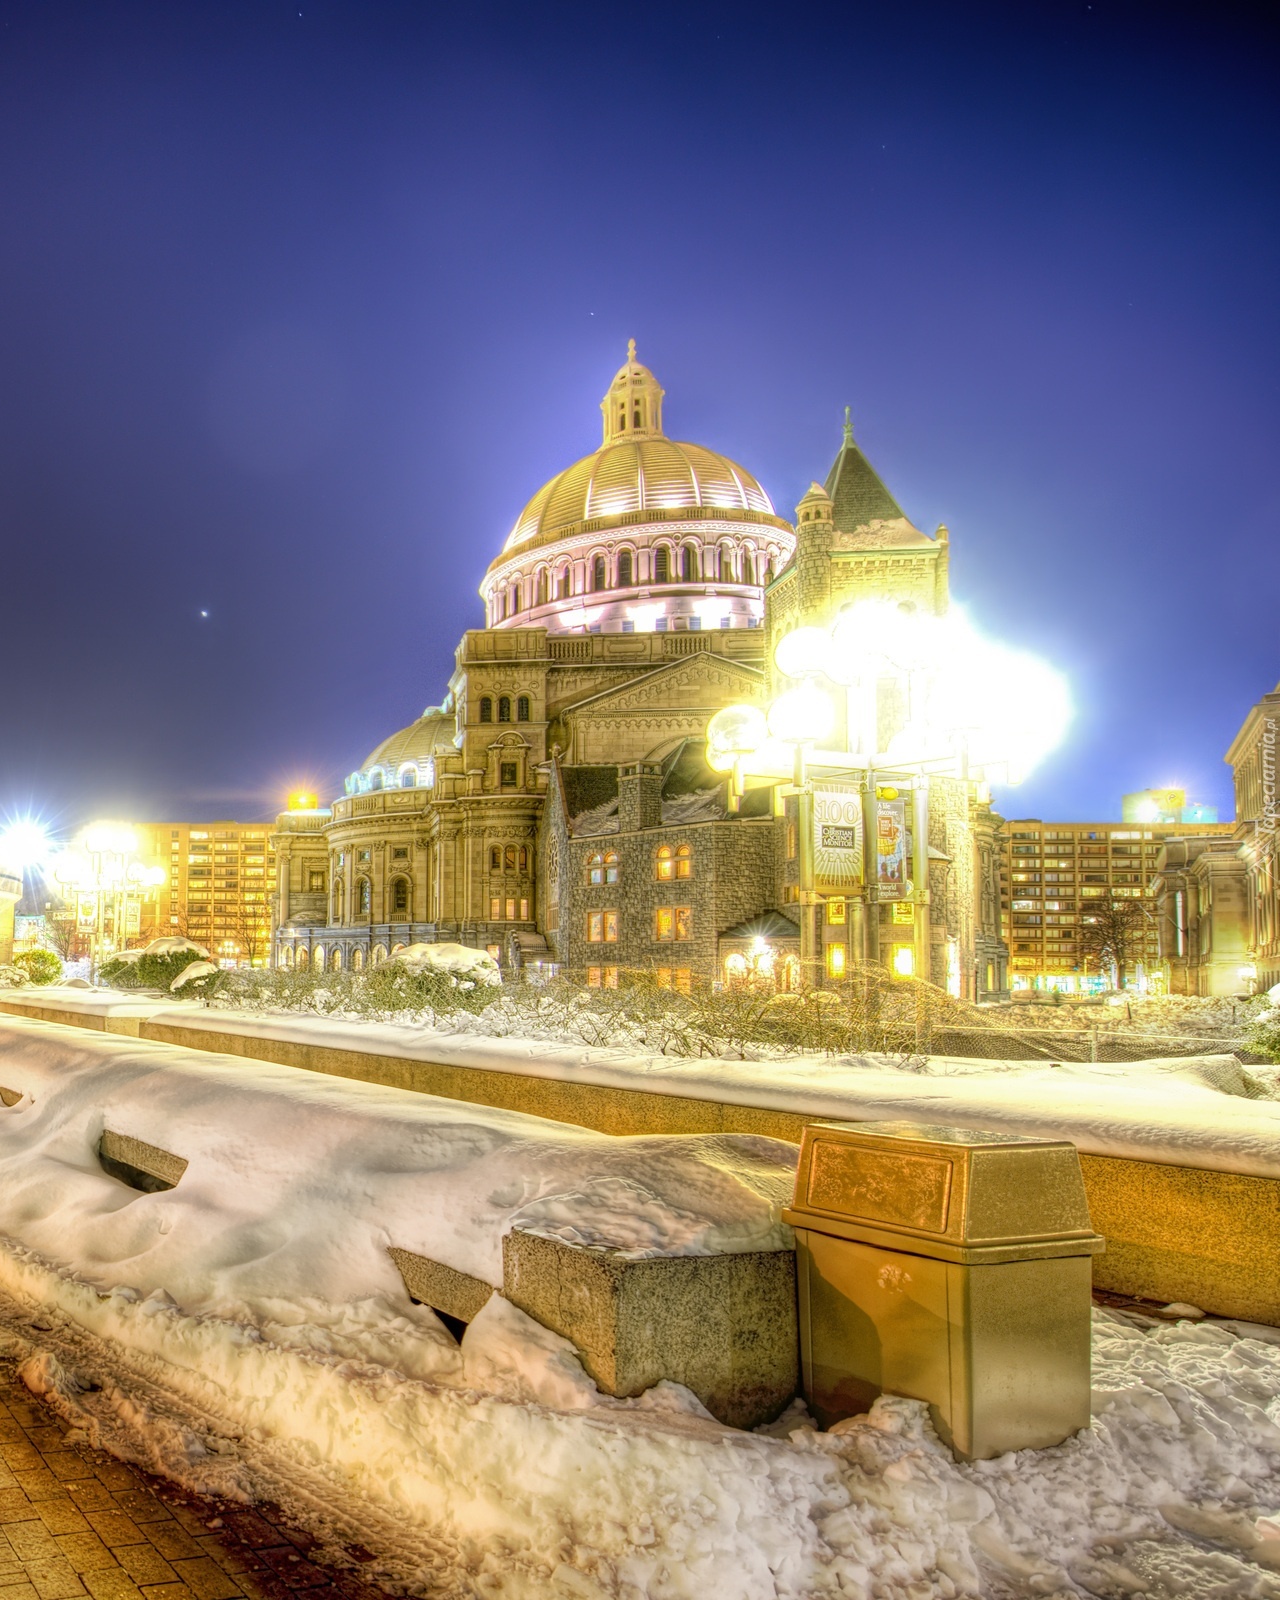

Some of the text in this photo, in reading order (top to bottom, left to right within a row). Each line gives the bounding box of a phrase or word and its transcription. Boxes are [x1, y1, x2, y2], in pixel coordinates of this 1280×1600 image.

[818, 800, 859, 824] 100
[822, 827, 853, 836] CHRISTIAN
[823, 838, 853, 847] MONITOR
[817, 849, 860, 865] YEARS
[821, 878, 839, 887] SINCE
[881, 890, 900, 898] explore.
